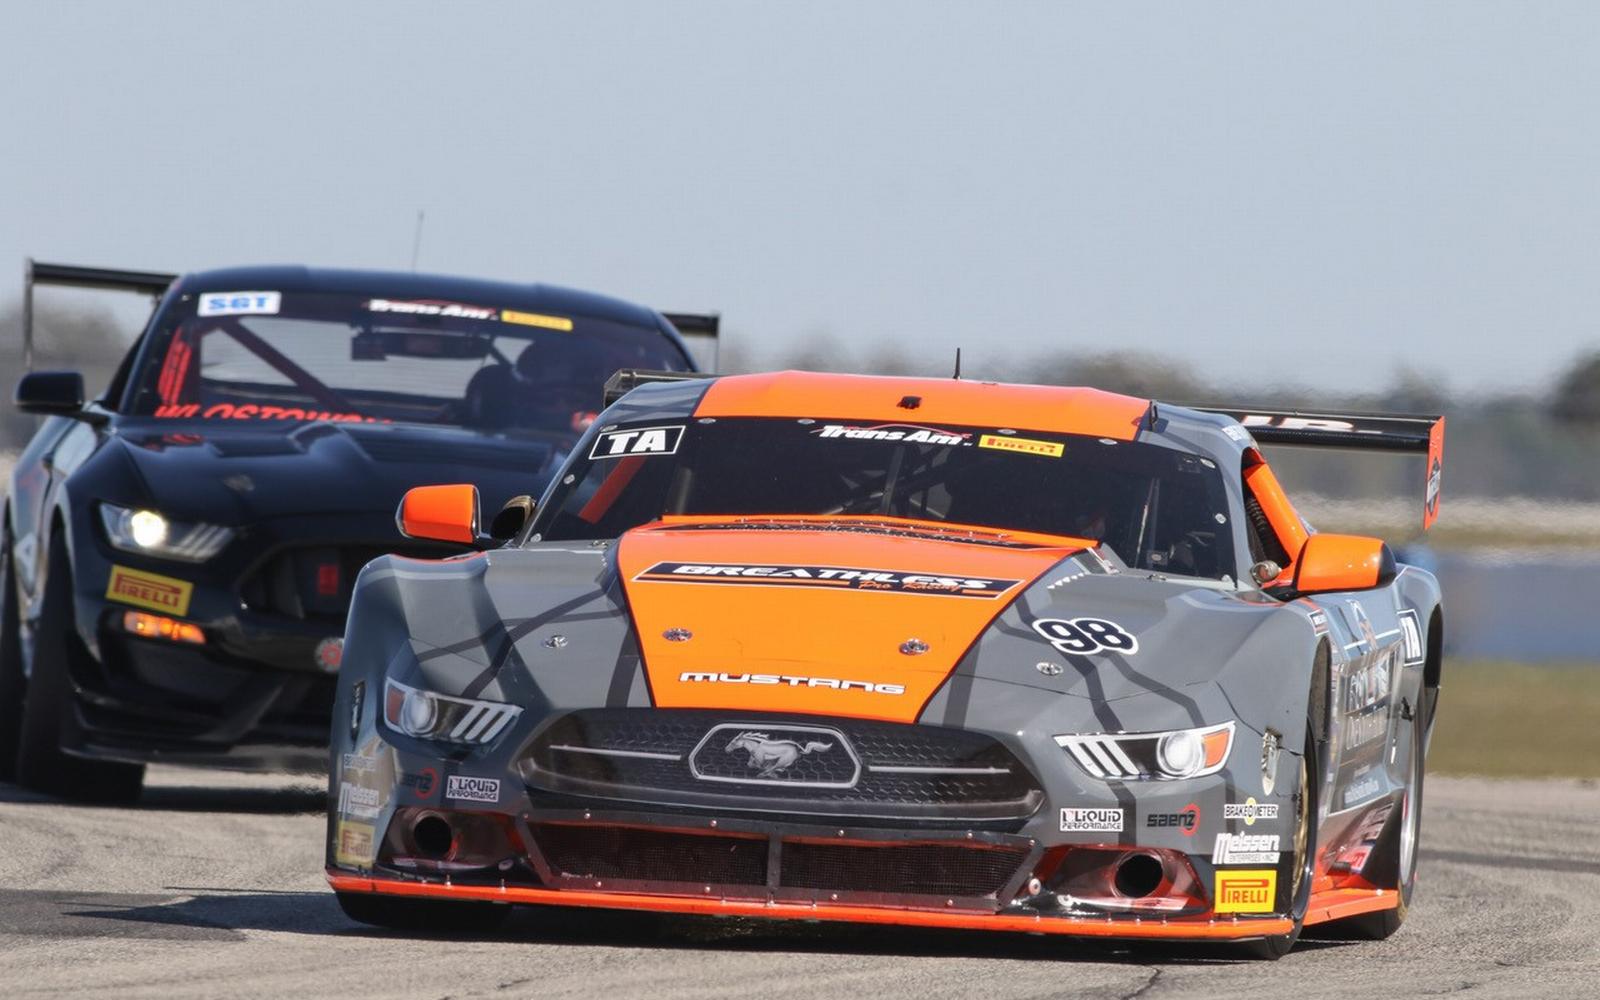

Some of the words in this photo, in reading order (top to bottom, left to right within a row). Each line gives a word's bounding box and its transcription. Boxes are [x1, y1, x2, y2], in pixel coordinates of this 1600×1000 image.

[608, 430, 666, 454] TA
[819, 425, 902, 441] Trans
[903, 430, 963, 446] Am
[673, 564, 993, 589] BREATHLESS
[113, 573, 183, 608] PIRELLI
[1033, 618, 1138, 654] 98
[678, 671, 906, 696] MUSTANG
[1212, 831, 1281, 864] Meissen
[1221, 879, 1270, 904] PIRELLI
